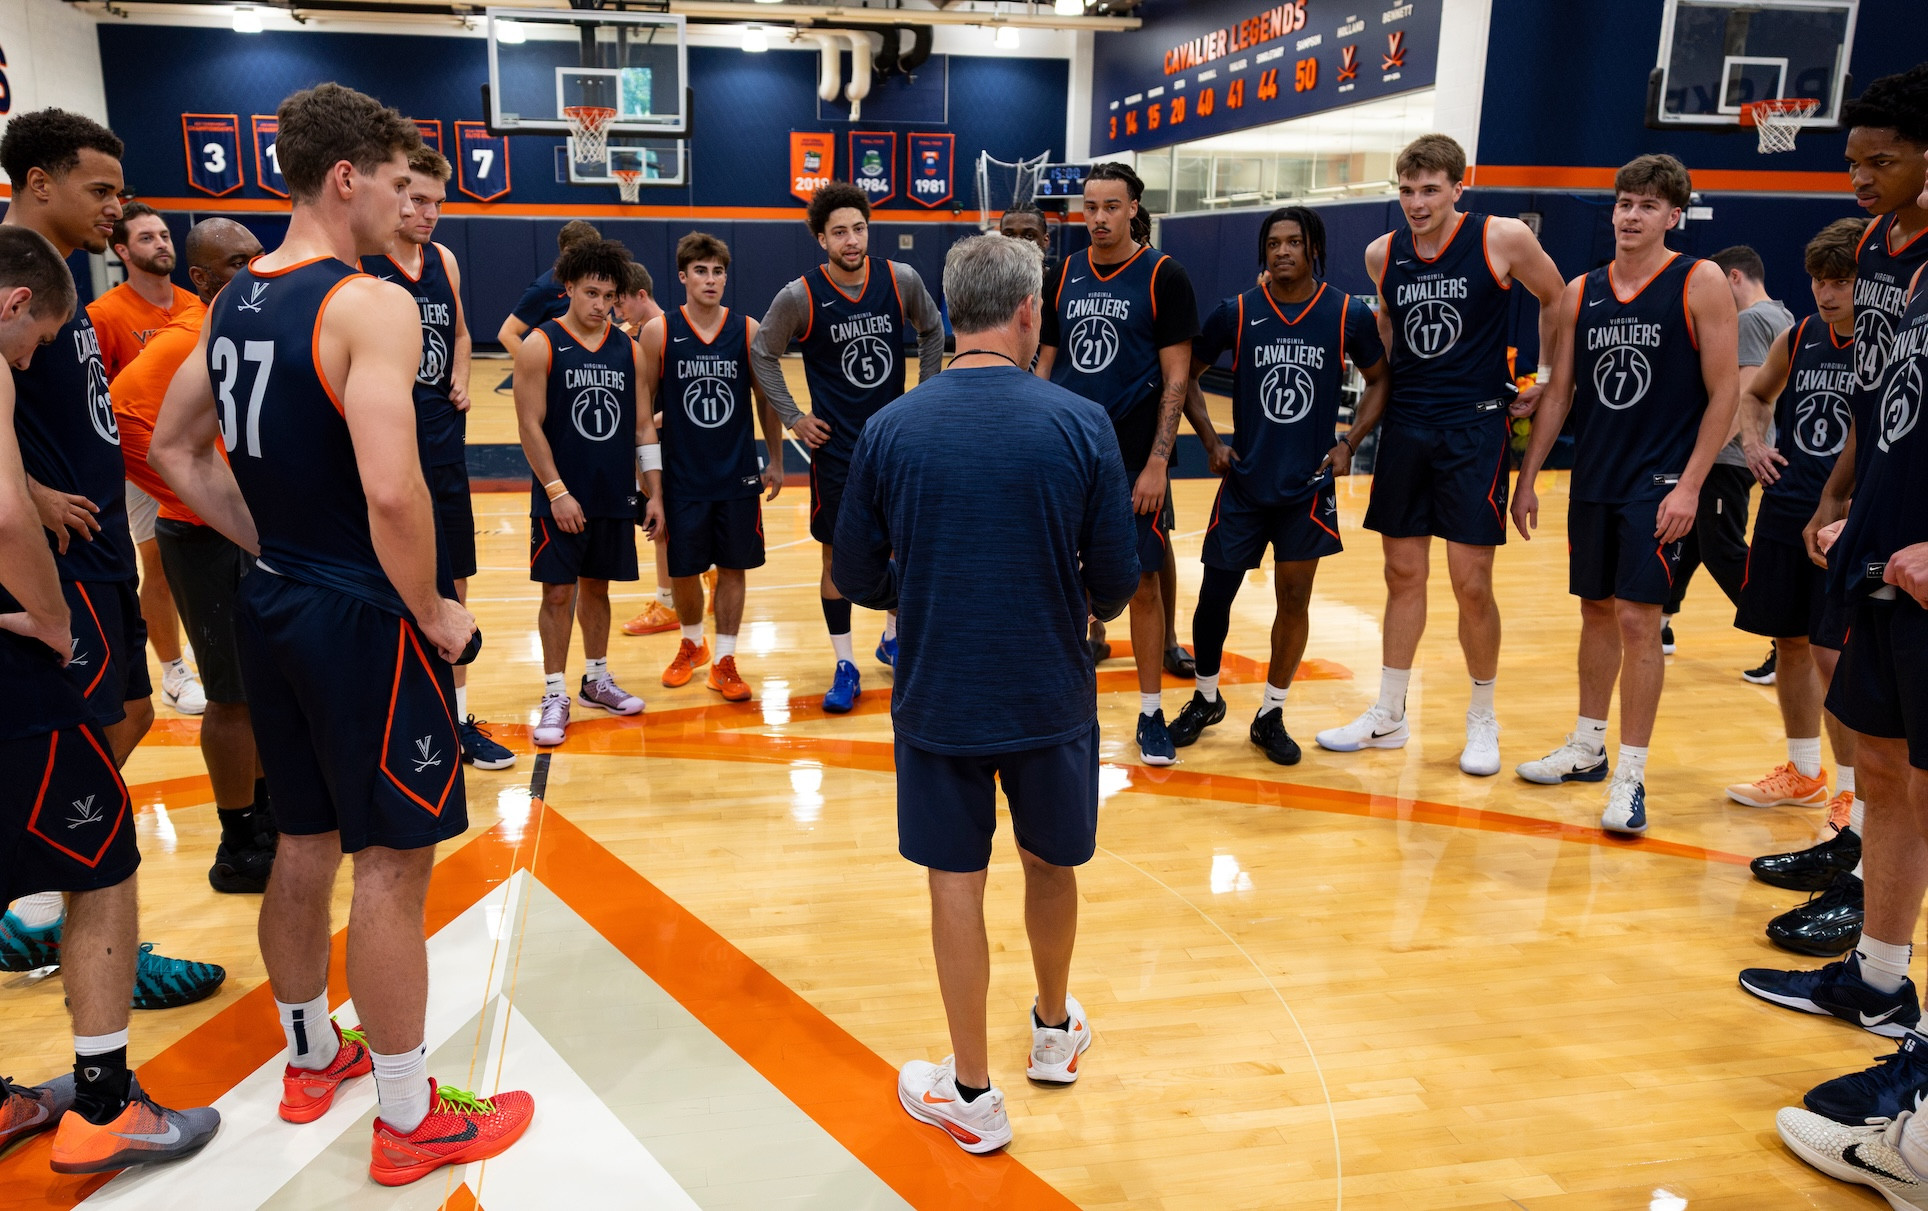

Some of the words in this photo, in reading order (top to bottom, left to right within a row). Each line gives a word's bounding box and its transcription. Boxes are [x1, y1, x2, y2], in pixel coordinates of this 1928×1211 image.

[1164, 29, 1228, 76] CAVALIER
[1229, 0, 1307, 53] LEGENDS
[1109, 116, 1117, 140] 3
[1147, 103, 1161, 130] 15
[1170, 96, 1186, 125] 20
[1196, 88, 1215, 117] 40
[1227, 79, 1245, 109] 41
[1257, 68, 1278, 101] 44
[1294, 57, 1318, 93] 50
[203, 143, 226, 173] 3
[472, 149, 494, 178] 7
[795, 177, 830, 191] 2019
[856, 177, 889, 192] 1984
[915, 179, 945, 193] 1981
[1051, 168, 1080, 180] 15:00
[1417, 273, 1445, 282] VIRGINIA
[1874, 272, 1895, 284] VIRGINIA
[1397, 277, 1468, 306] CAVALIERS
[1854, 278, 1909, 319] CAVALIERS
[848, 312, 872, 321] VIRGINIA
[1066, 298, 1130, 320] CAVALIERS
[1610, 317, 1638, 325] VIRGINIA
[830, 314, 893, 343] CAVALIERS
[1421, 323, 1443, 351] 17
[1587, 324, 1661, 351] CAVALIERS
[1080, 339, 1102, 366] 21
[1254, 345, 1325, 370] CAVALIERS
[1857, 341, 1879, 381] 34
[677, 360, 738, 379] CAVALIERS
[861, 357, 875, 380] 5
[1820, 362, 1847, 370] VIRGINIA
[565, 368, 626, 391] CAVALIERS
[1615, 372, 1627, 400] 7
[1795, 369, 1856, 395] CAVALIER
[212, 336, 274, 458] 37
[701, 398, 718, 421] 11
[1275, 388, 1296, 416] 12
[594, 408, 603, 433] 1
[1812, 418, 1828, 447] 8
